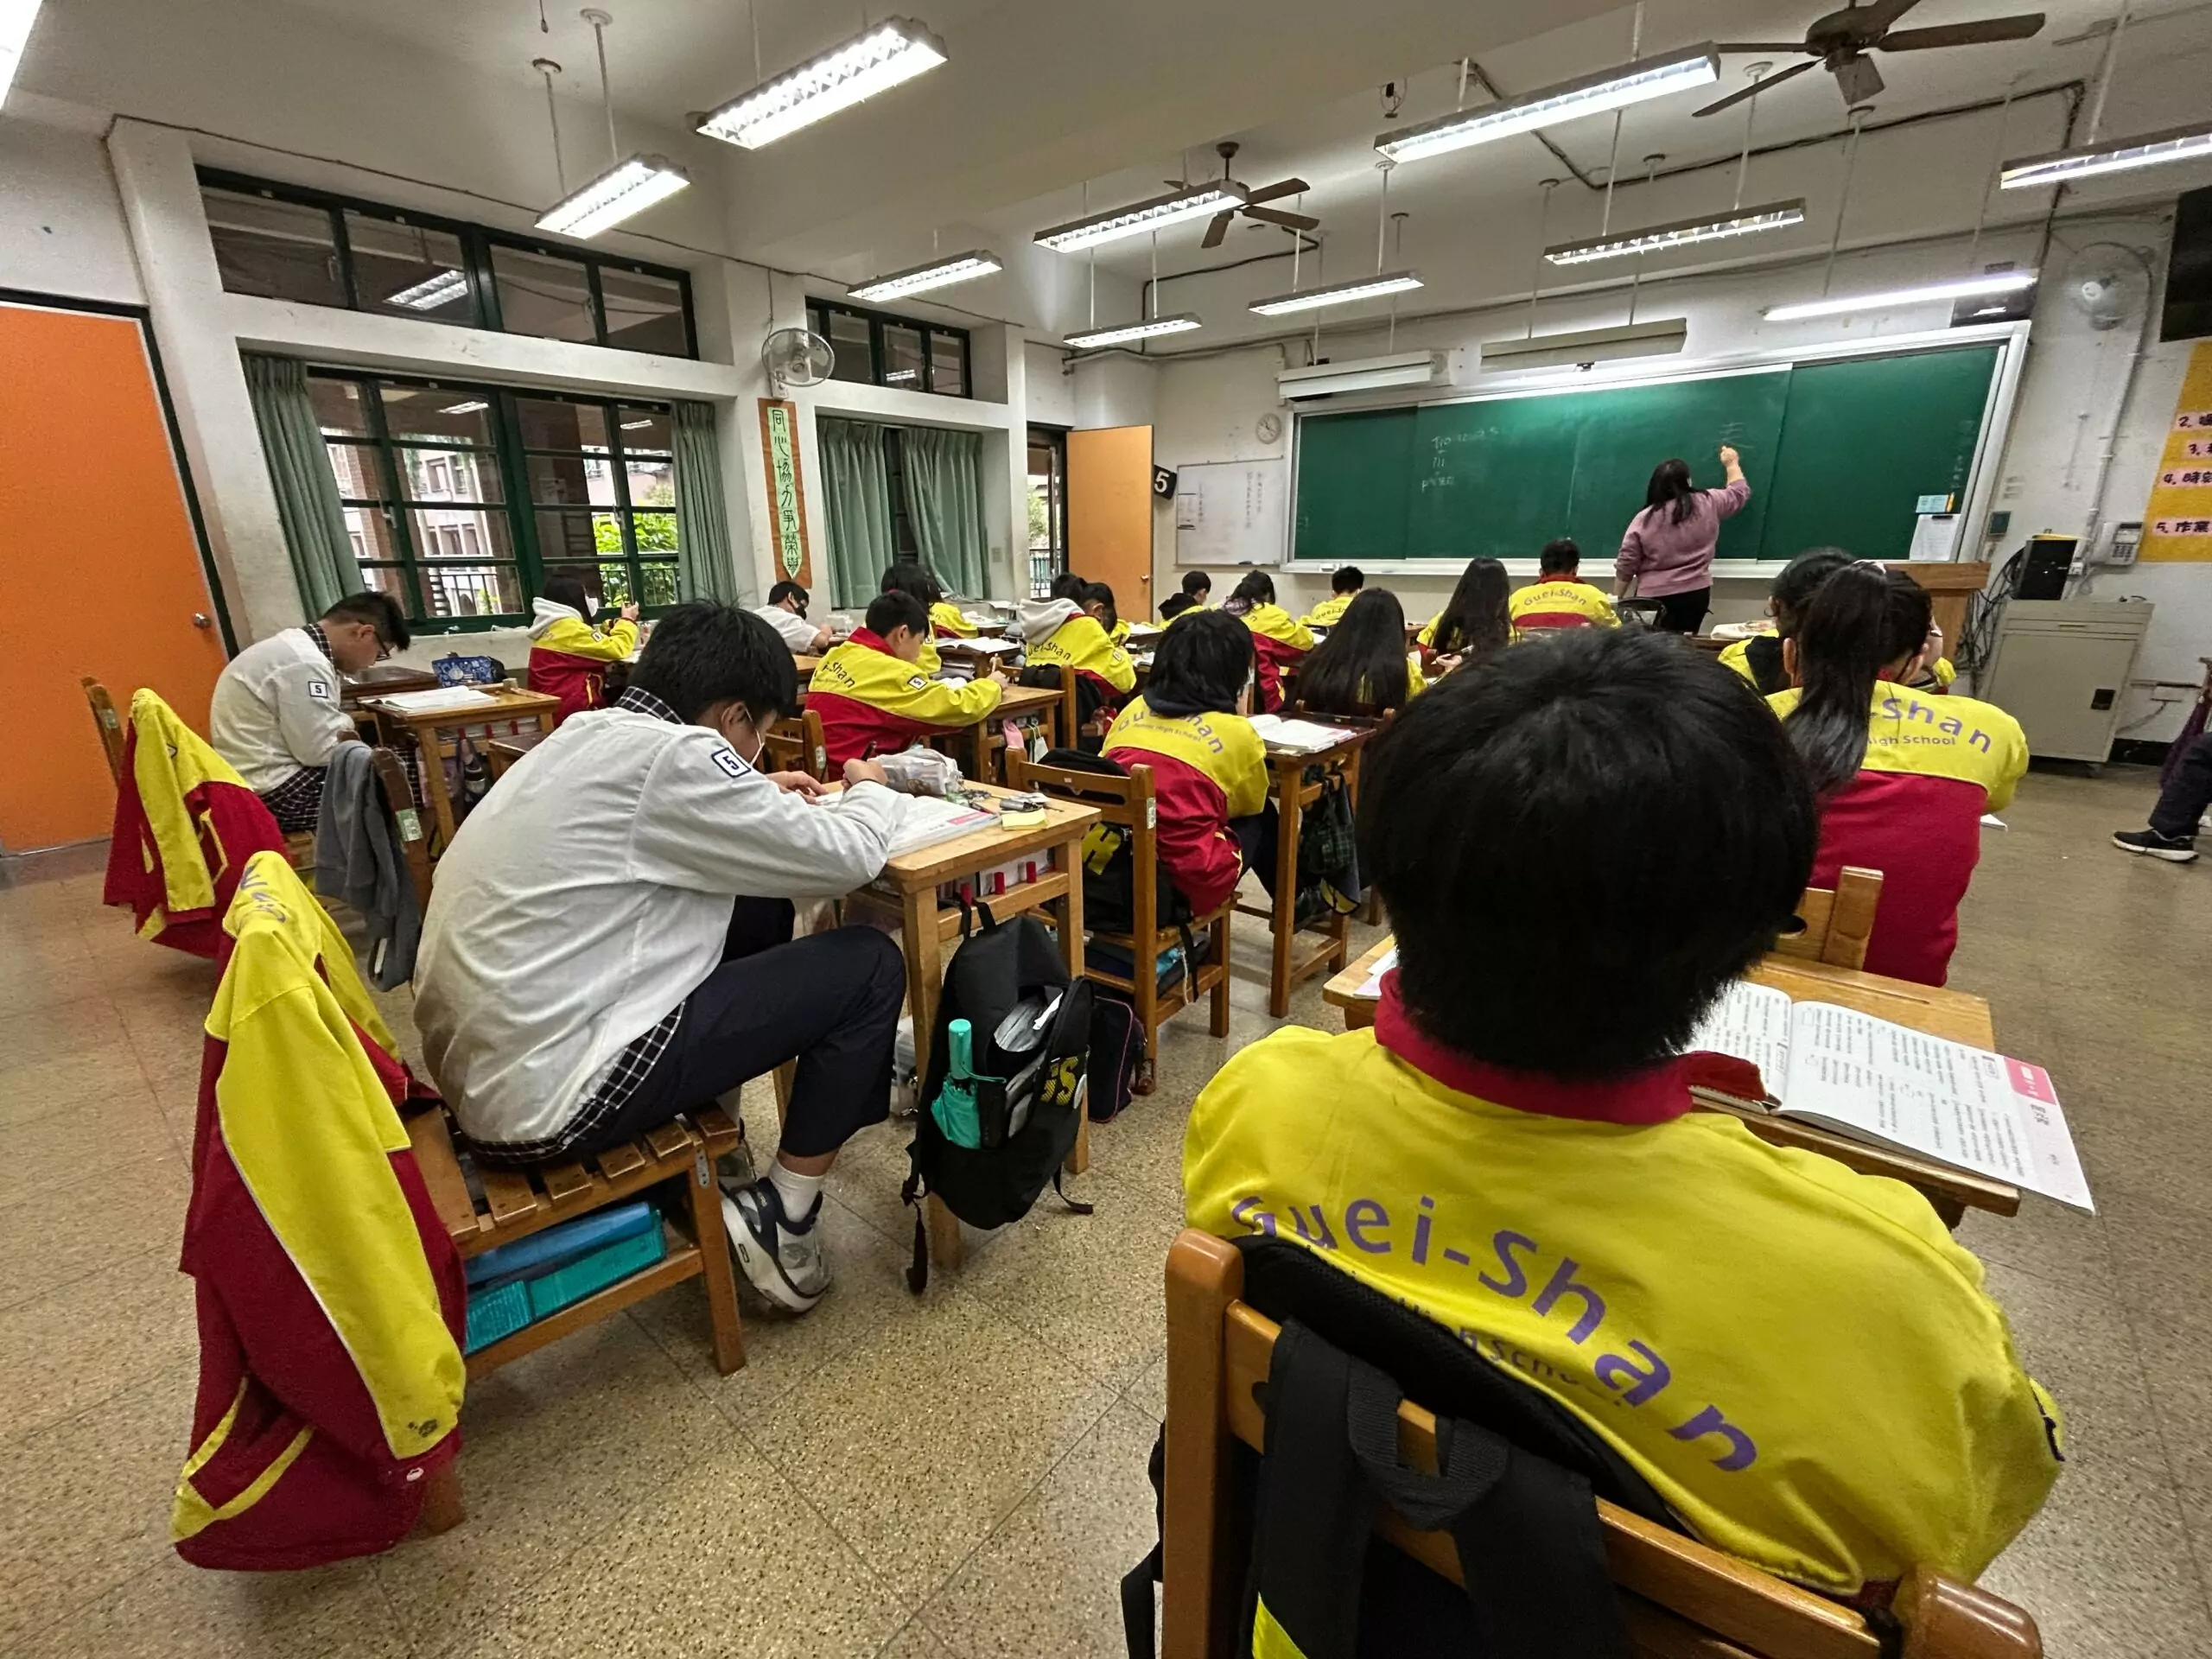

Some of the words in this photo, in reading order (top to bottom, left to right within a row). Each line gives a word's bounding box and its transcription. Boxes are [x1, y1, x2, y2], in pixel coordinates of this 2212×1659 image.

[2178, 416, 2191, 428] 2.
[2189, 443, 2201, 455] 3.
[1154, 471, 1170, 493] 5
[2157, 522, 2169, 533] 5.
[315, 684, 322, 694] 5
[1903, 735, 1955, 745] School
[722, 755, 740, 771] 5
[1231, 1196, 1757, 1471] Guei-Shan
